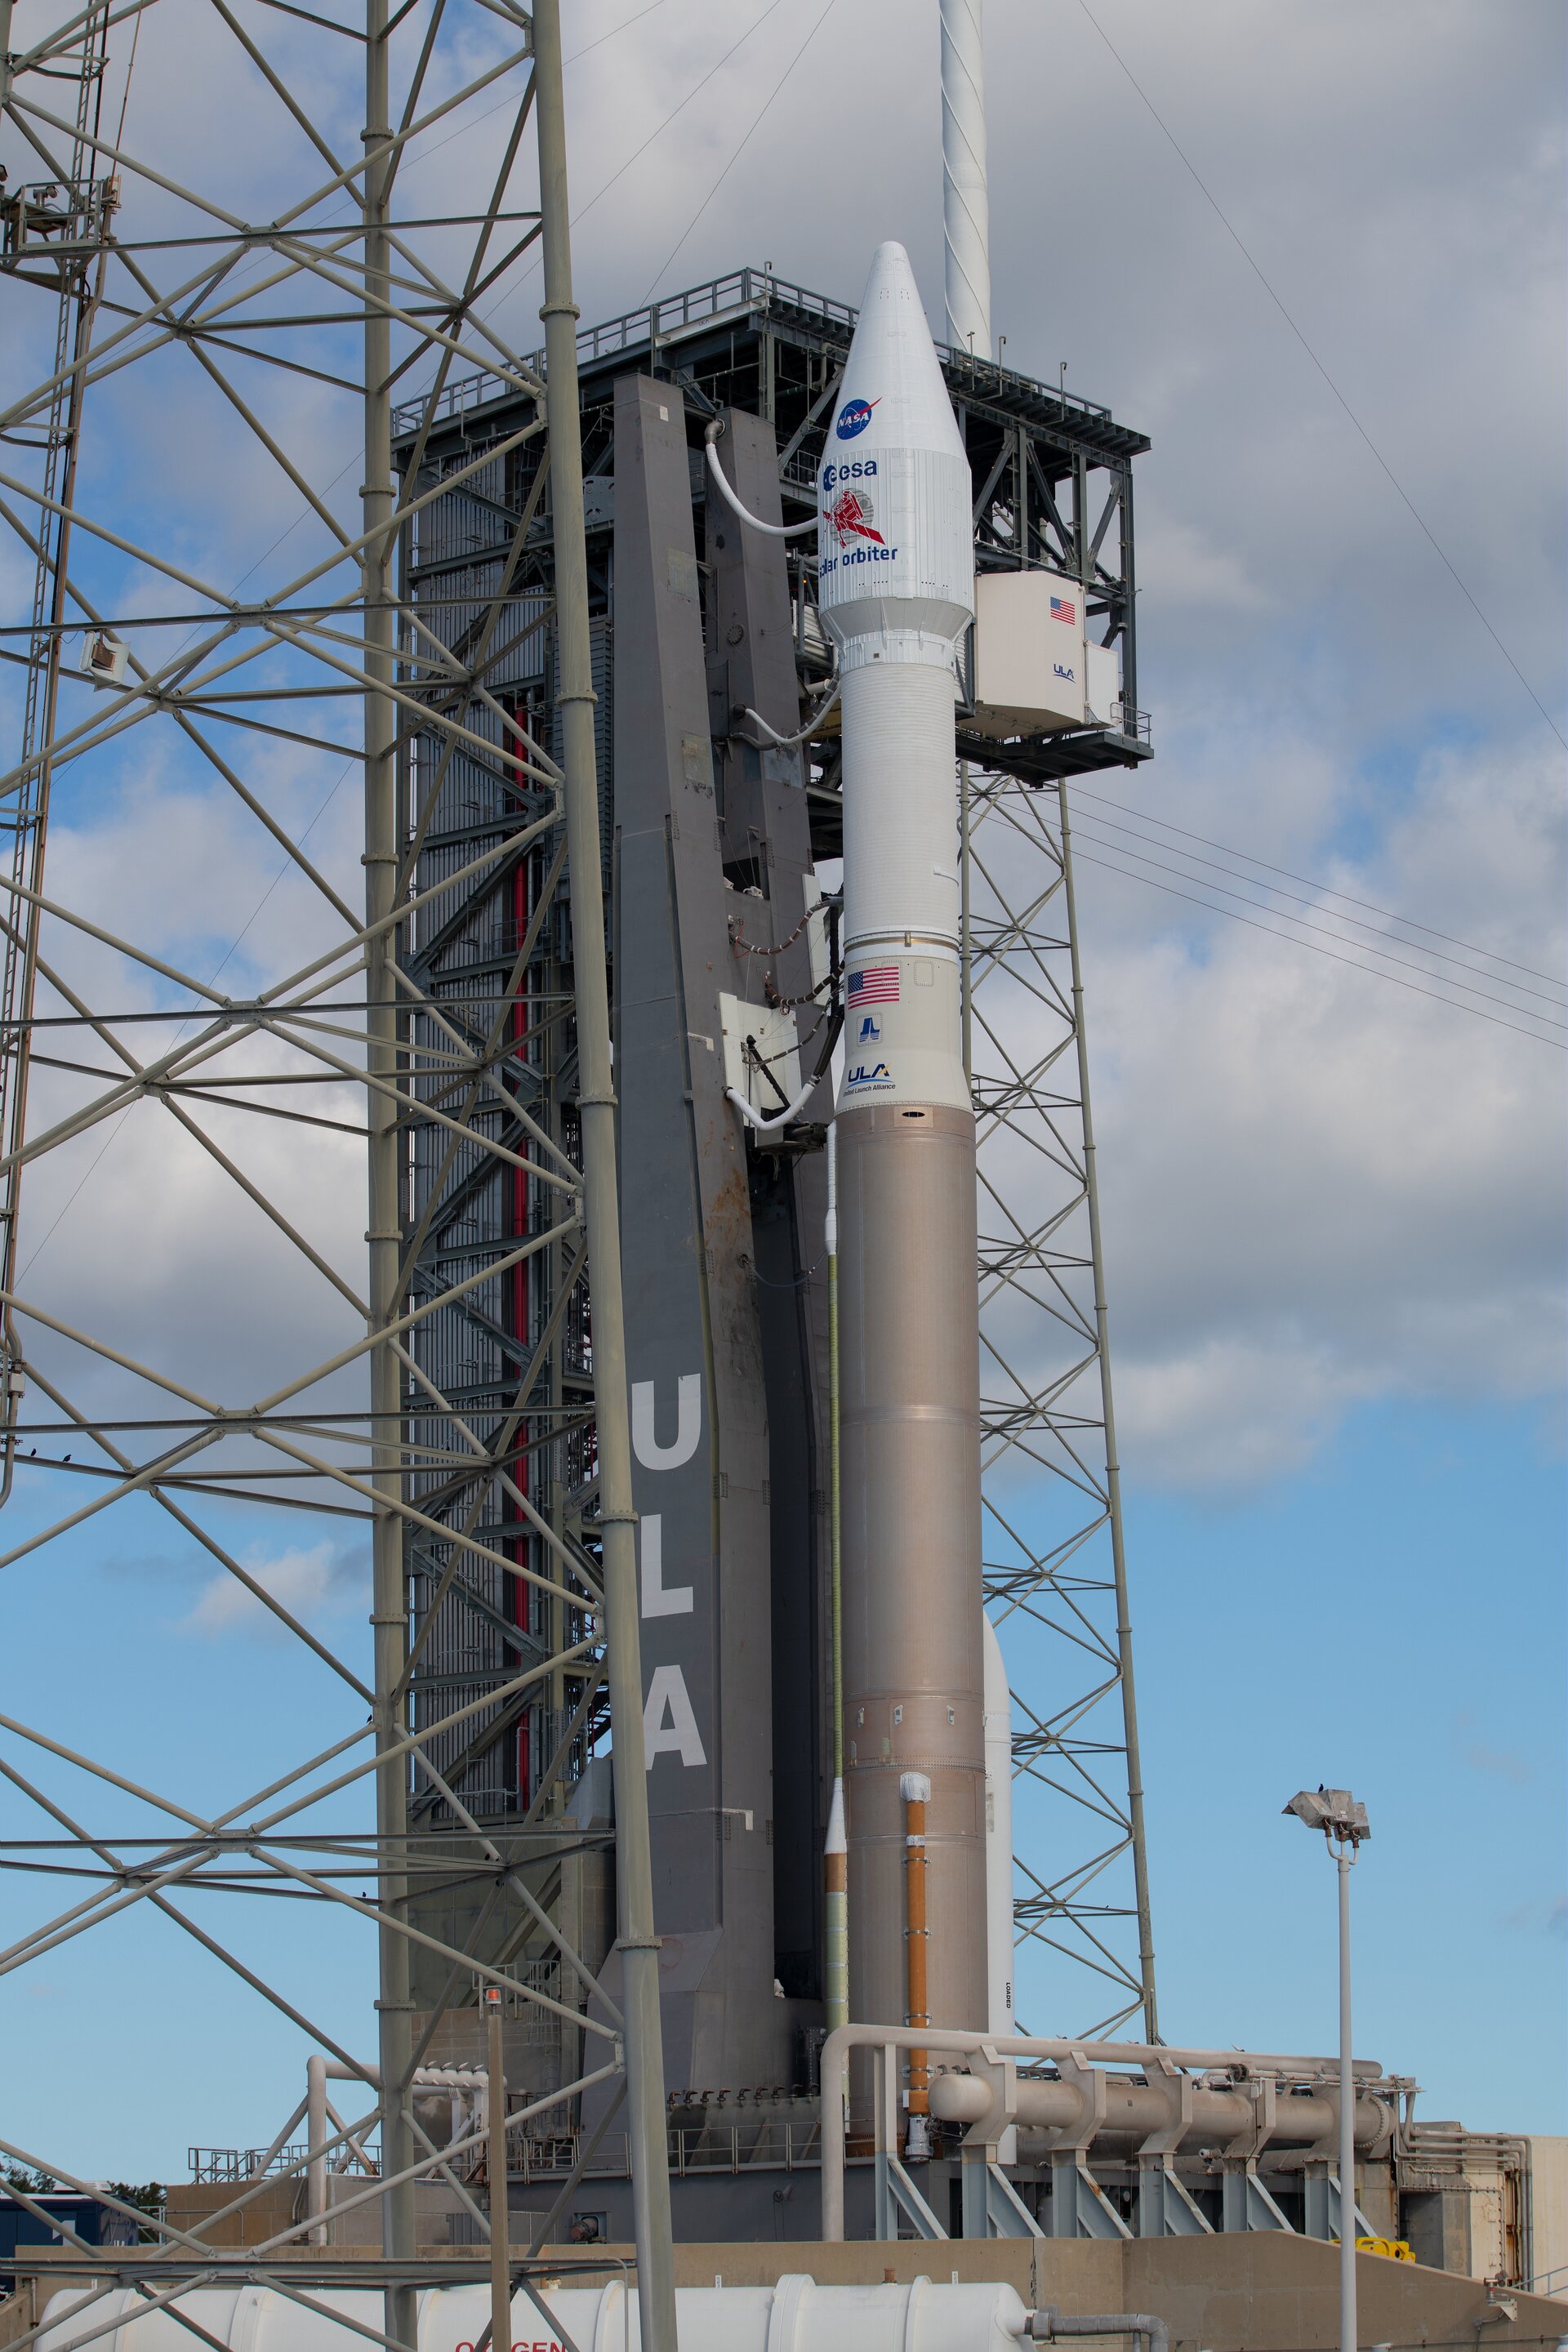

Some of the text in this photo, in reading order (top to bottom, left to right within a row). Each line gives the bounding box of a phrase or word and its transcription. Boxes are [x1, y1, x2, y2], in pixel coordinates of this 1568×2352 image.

[838, 412, 869, 428] NASA
[840, 460, 877, 480] esa
[843, 546, 898, 566] orbiter
[1054, 663, 1074, 679] ULA
[848, 1063, 889, 1082] ULA
[855, 1085, 871, 1094] Launch
[631, 1373, 707, 1771] ULA
[455, 2341, 565, 2352] OGEN
